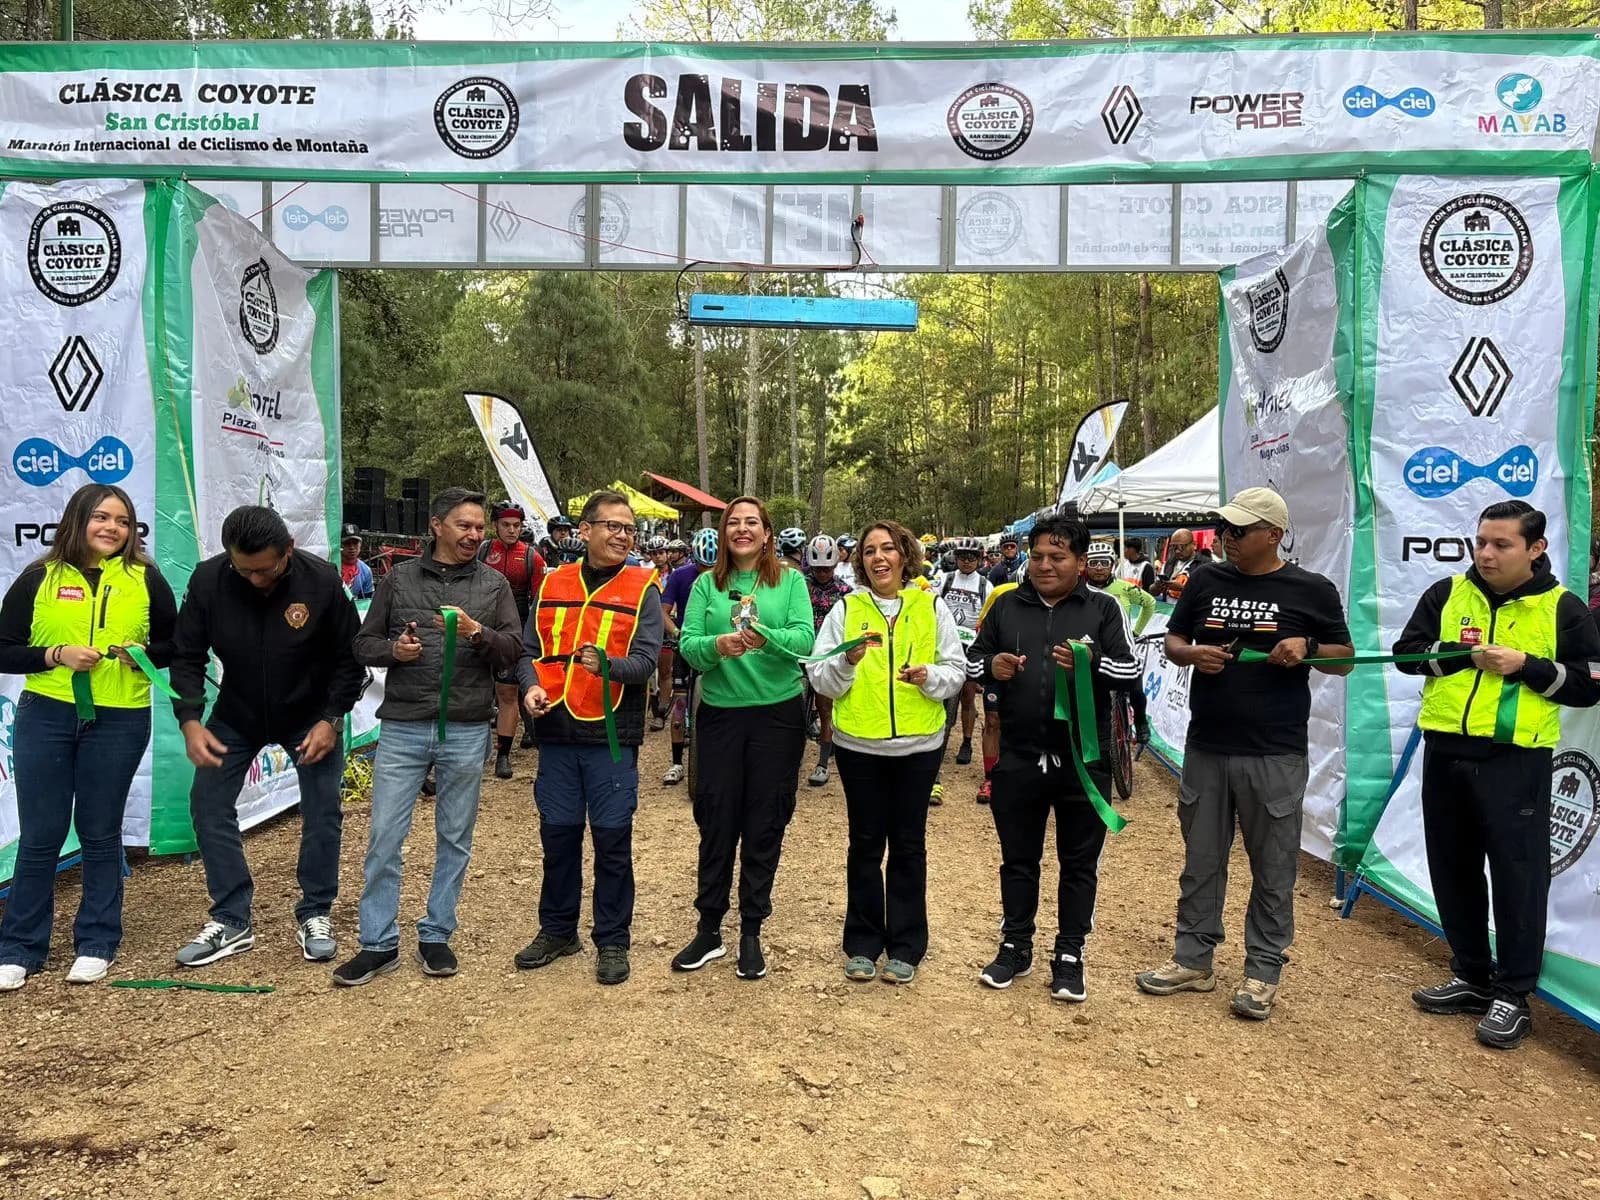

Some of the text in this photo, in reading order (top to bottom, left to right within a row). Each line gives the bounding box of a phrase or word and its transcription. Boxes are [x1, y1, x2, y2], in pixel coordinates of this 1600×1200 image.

[59, 77, 316, 105] CLÁSICA COYOTE
[1190, 91, 1305, 115] POWER
[1346, 91, 1431, 111] ciel ciel
[448, 105, 505, 119] CLÁSICA
[623, 73, 879, 151] SALIDA
[961, 110, 1019, 121] CLÁSICA
[1236, 111, 1303, 130] ADE
[105, 111, 260, 131] San Cristóbal
[452, 119, 502, 130] COYOTE
[965, 120, 1017, 129] COYOTE
[1478, 113, 1567, 133] MAYAB
[8, 137, 369, 154] Maratón Internacional de Ciclismo de Montaña
[43, 241, 106, 256] CLÁSICA
[1439, 237, 1514, 252] CLÁSICA
[45, 257, 102, 270] COYOTE
[1444, 253, 1510, 266] COYOTE
[222, 412, 257, 430] Plaza
[16, 446, 125, 474] ciel ciel
[1407, 455, 1534, 484] ciel ciel
[1211, 597, 1280, 613] CLÁSICA
[1211, 607, 1274, 620] COYOTE
